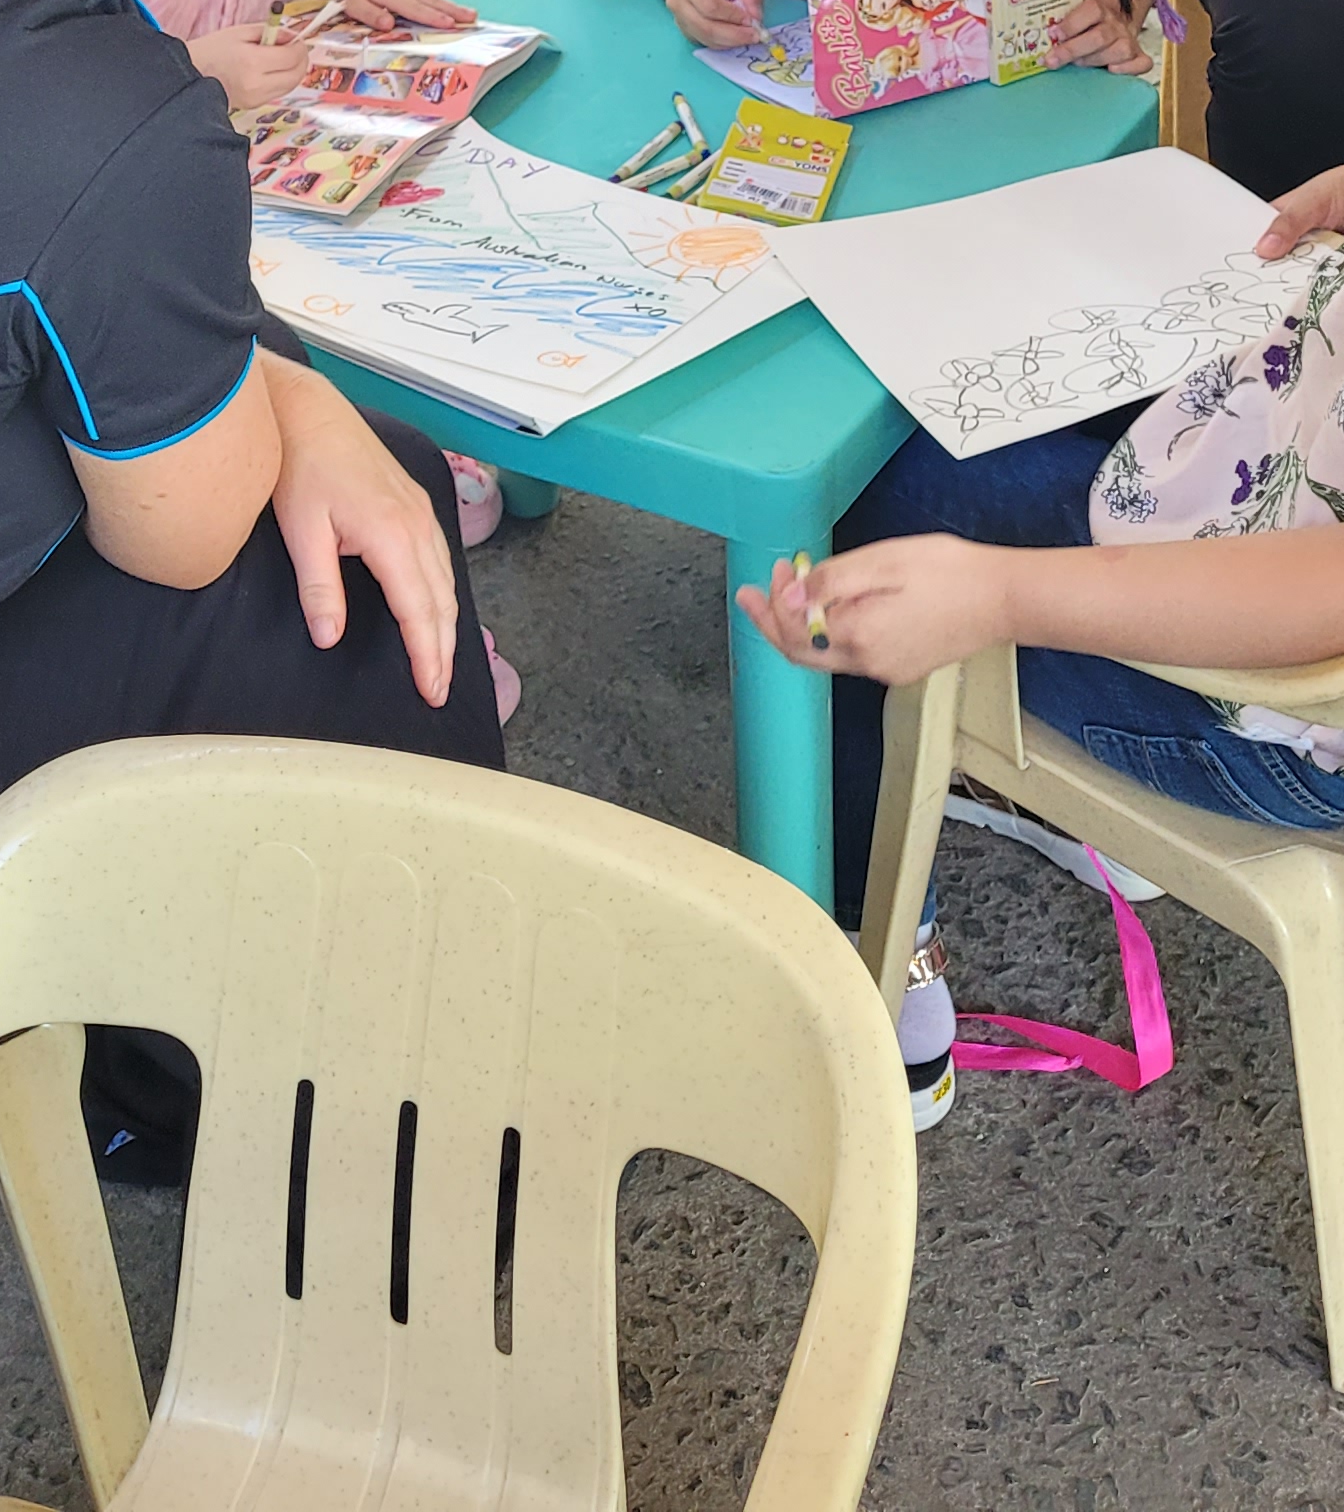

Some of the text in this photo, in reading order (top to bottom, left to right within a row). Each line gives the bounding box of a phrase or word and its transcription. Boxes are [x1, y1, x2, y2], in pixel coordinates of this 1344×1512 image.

[400, 206, 669, 302] From Australian Nurses
